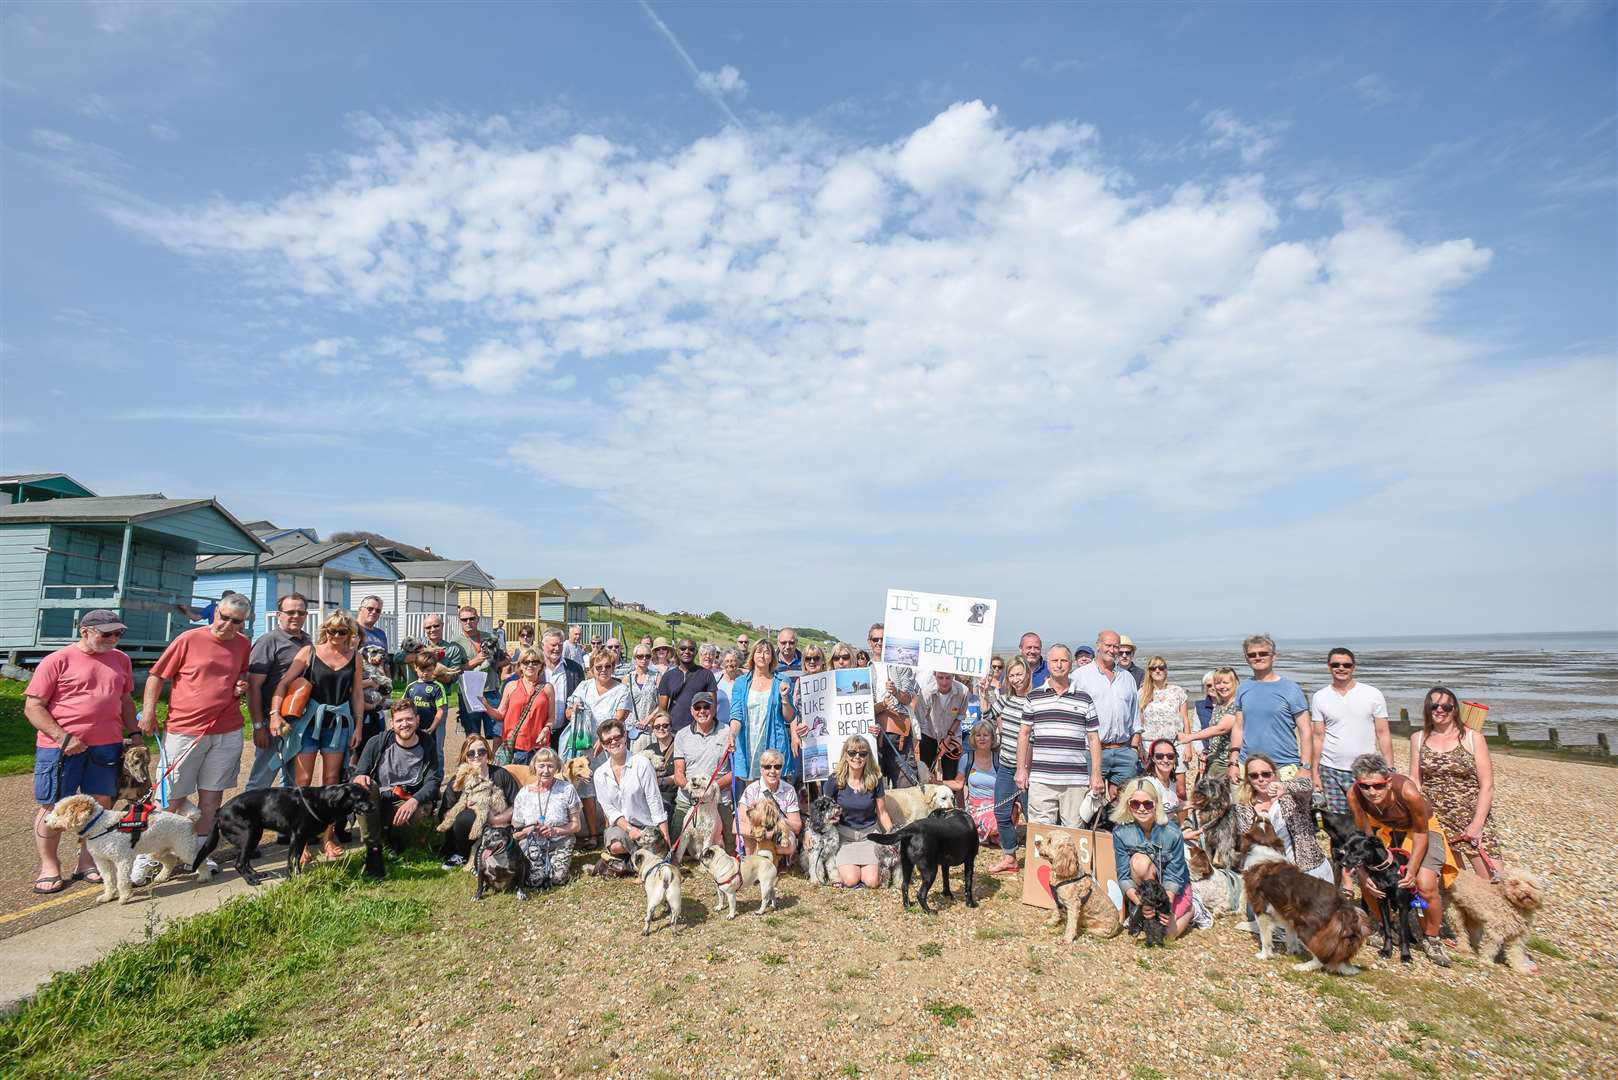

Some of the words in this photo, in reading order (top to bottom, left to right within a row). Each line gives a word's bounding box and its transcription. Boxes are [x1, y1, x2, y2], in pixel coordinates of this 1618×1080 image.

[891, 593, 919, 612] IT'S
[913, 616, 941, 633] OUR
[924, 637, 964, 656] BEACH
[802, 681, 811, 695] I
[813, 677, 827, 693] DO
[803, 697, 825, 715] LIKE
[836, 702, 853, 716] TO
[855, 701, 870, 715] BE
